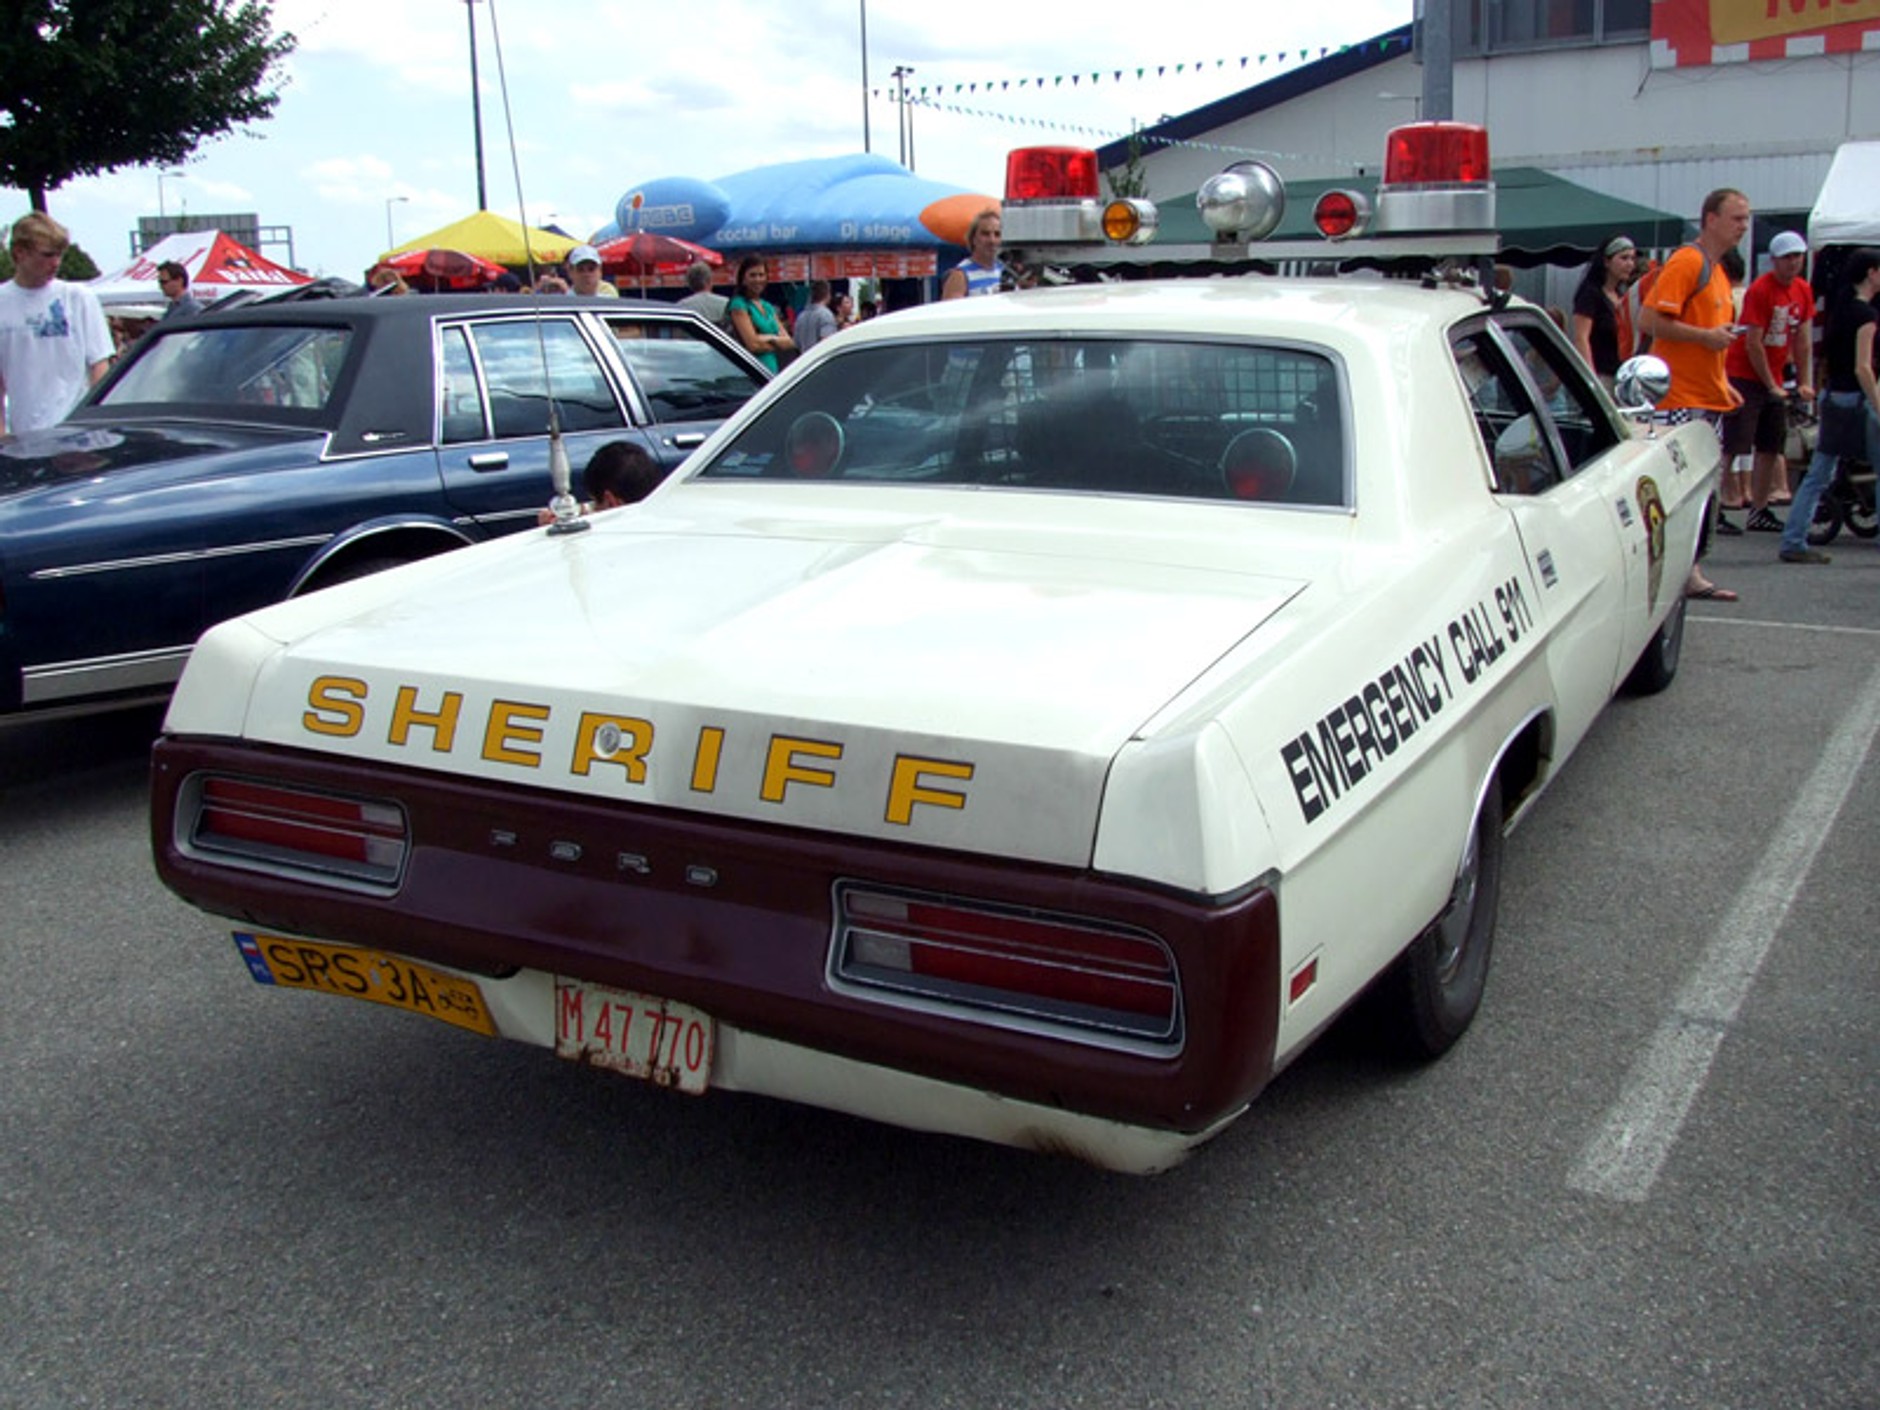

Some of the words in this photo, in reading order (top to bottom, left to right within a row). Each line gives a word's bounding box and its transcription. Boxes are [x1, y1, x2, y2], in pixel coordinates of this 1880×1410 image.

[715, 224, 767, 241] coctail
[771, 223, 798, 239] bar
[864, 224, 912, 240] stage
[1280, 634, 1453, 824] EMERGENCY
[1448, 601, 1505, 684] CALL
[1494, 576, 1533, 642] 911
[302, 675, 975, 825] SHERIFF
[491, 829, 717, 886] FORD
[267, 944, 369, 993] SRS
[379, 960, 436, 1011] 3A
[562, 985, 584, 1043] M
[594, 1001, 634, 1054] 47
[644, 1009, 705, 1072] 770
